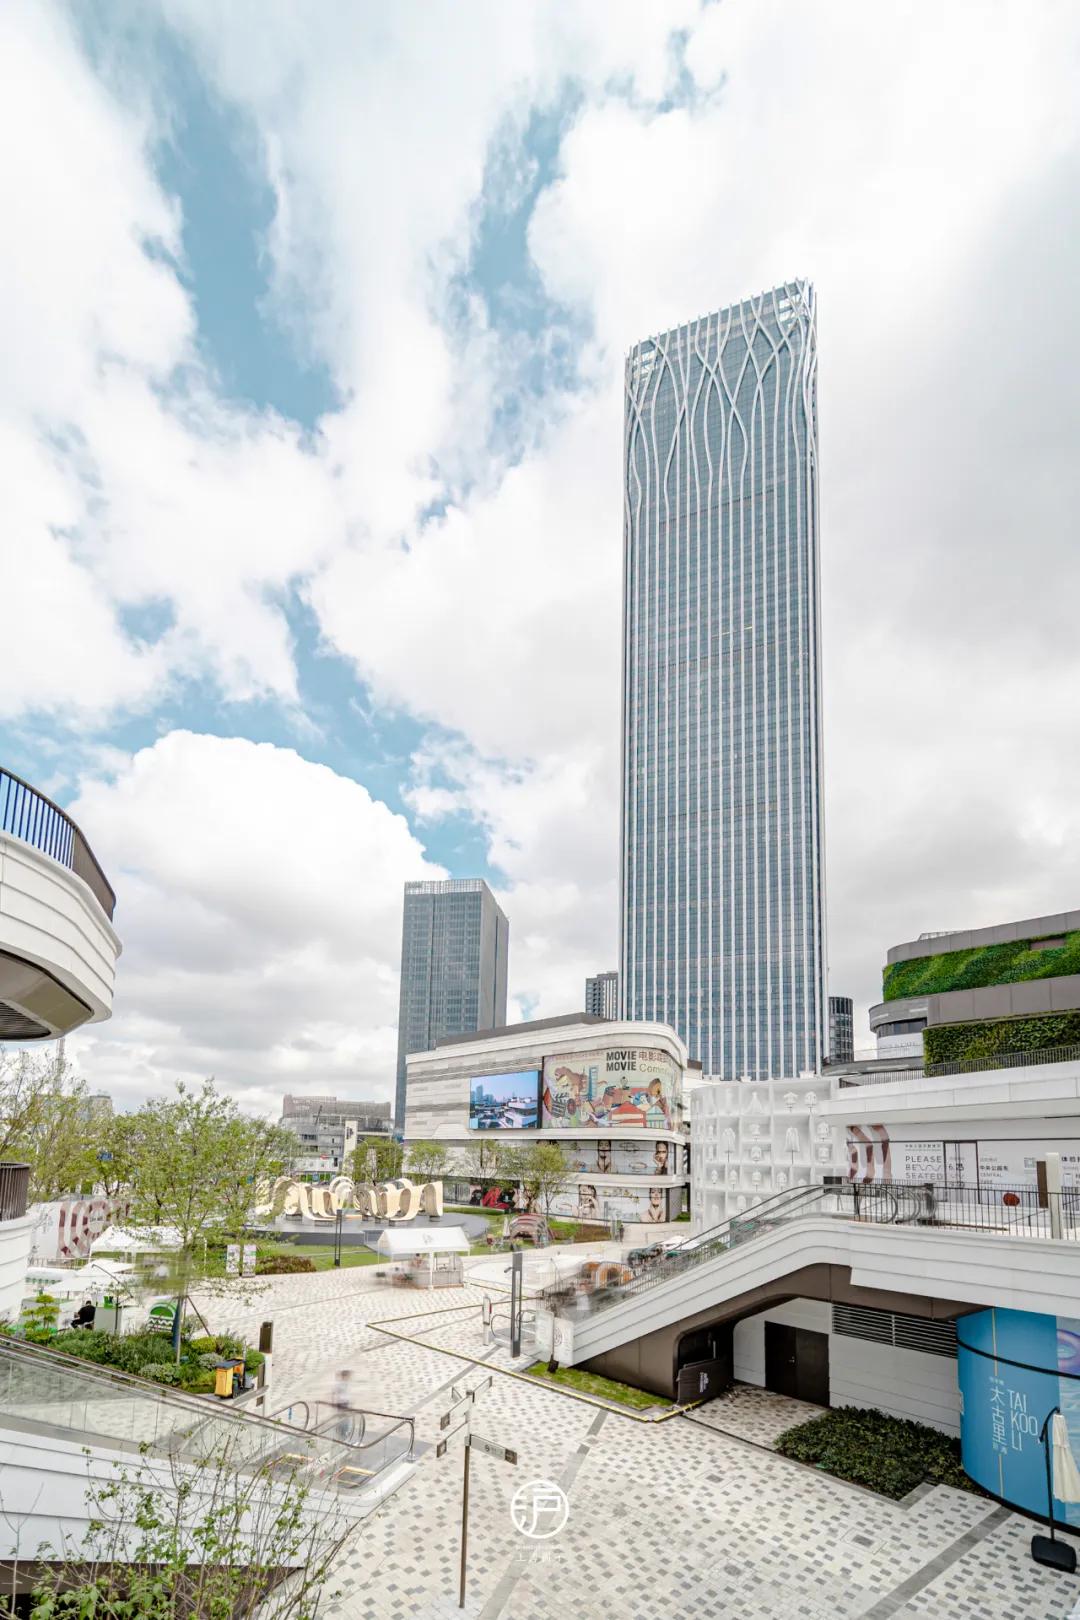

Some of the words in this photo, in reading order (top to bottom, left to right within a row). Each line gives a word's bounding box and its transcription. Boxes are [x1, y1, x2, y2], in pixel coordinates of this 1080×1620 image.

[606, 1050, 637, 1061] MOVIE
[606, 1061, 637, 1072] MOVIE
[905, 1155, 942, 1163] PLEASE
[905, 1172, 943, 1180] SEATED
[1007, 1388, 1027, 1413] TAI
[1010, 1410, 1038, 1436] KOO
[1011, 1429, 1023, 1451] LI
